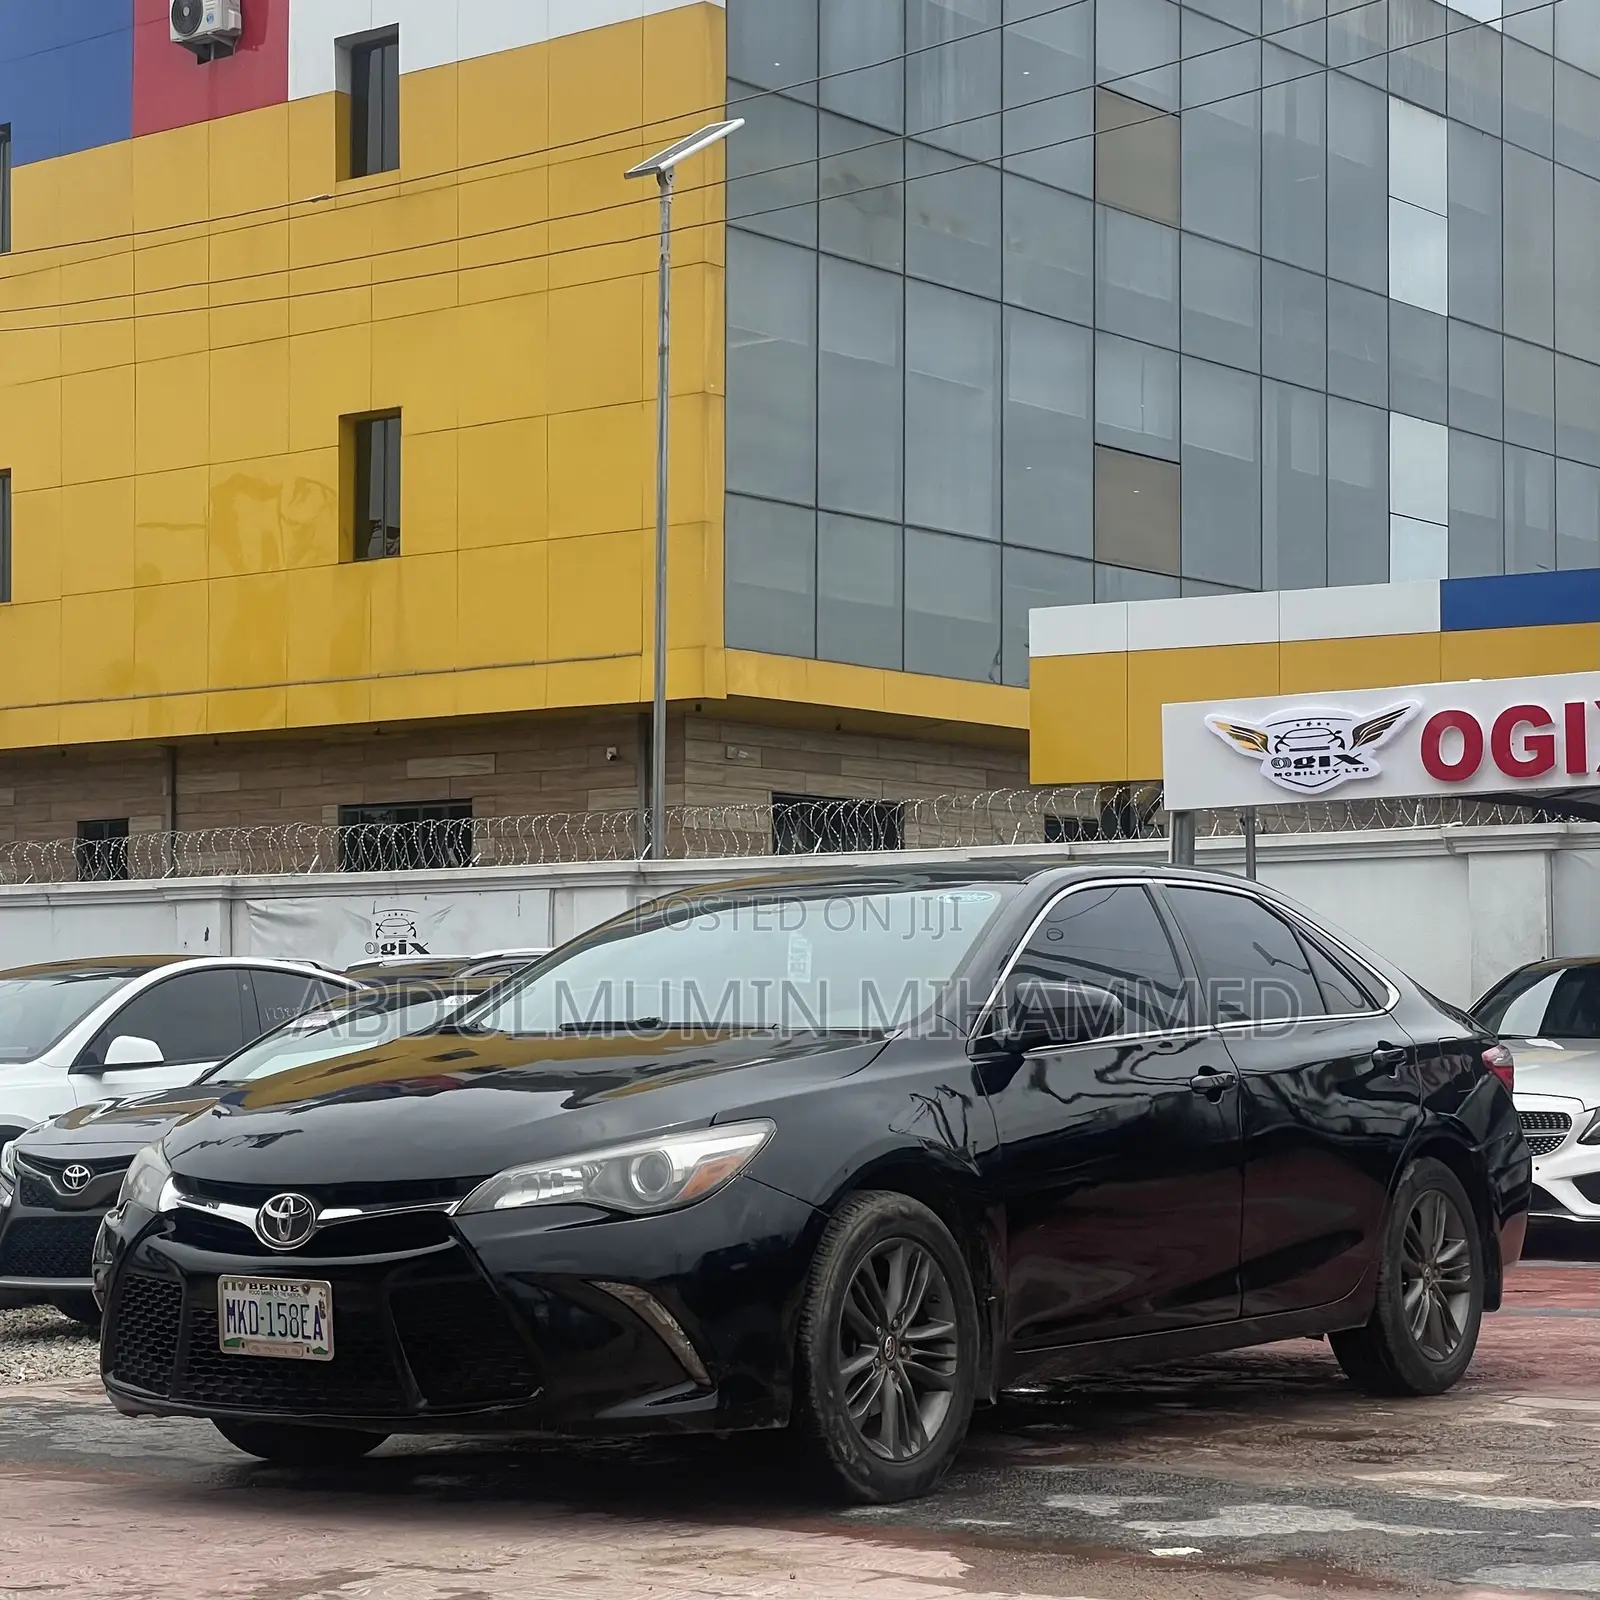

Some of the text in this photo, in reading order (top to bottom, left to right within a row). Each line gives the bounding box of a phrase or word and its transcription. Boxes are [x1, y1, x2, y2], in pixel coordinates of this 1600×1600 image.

[1274, 769, 1340, 777] MOBILITY
[249, 1283, 300, 1292] BENUE
[226, 1298, 324, 1341] MKD-158EA
